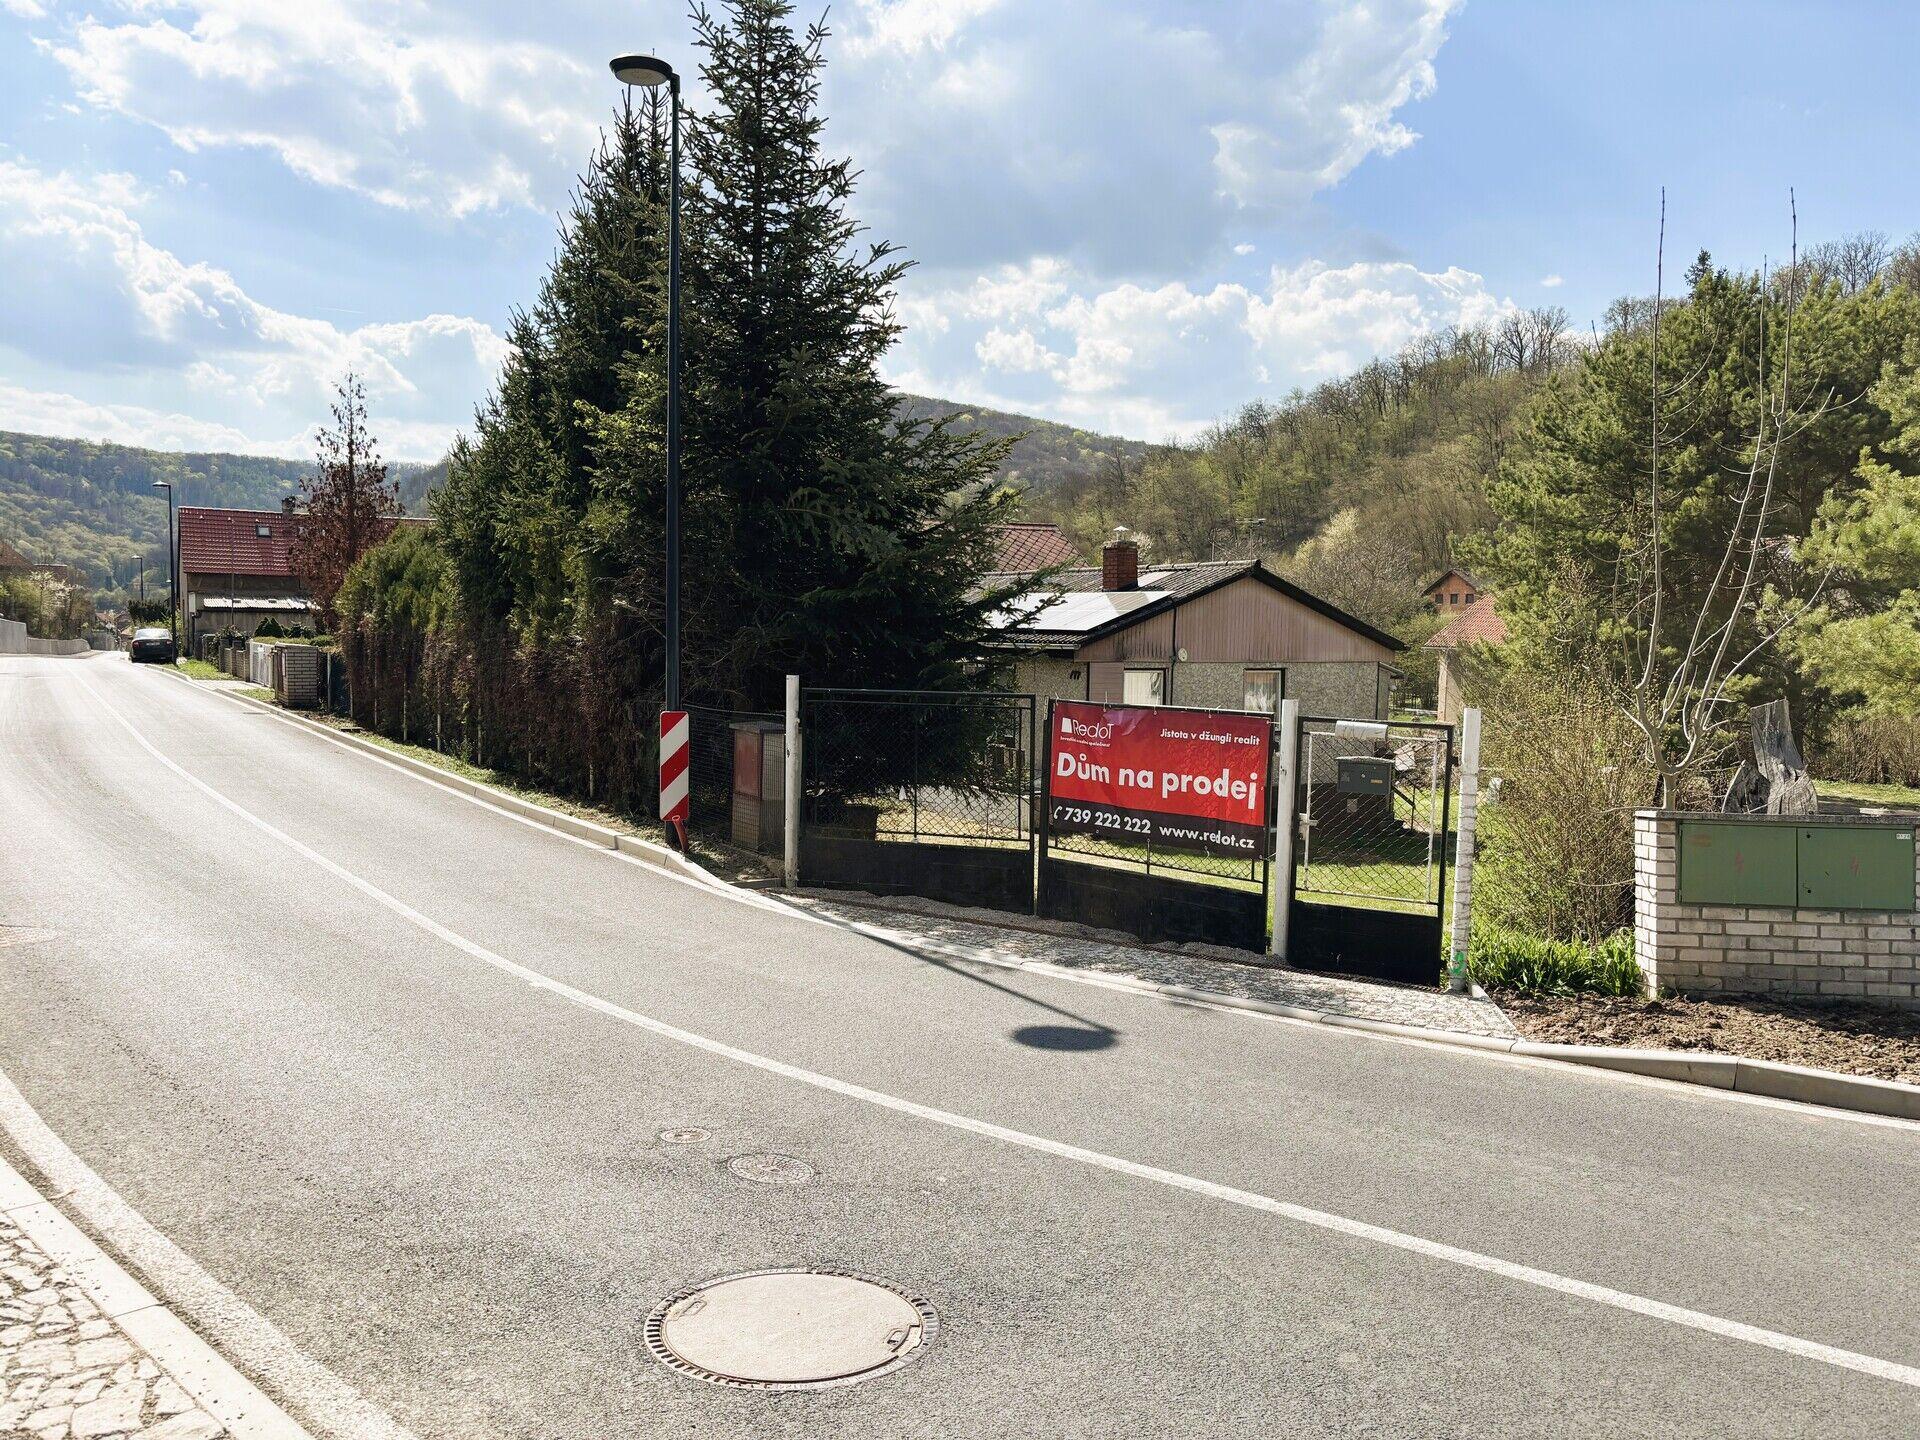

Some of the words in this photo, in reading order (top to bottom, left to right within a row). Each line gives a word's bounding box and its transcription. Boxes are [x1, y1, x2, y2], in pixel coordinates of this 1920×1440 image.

[1160, 729, 1188, 739] Jistota
[1191, 732, 1197, 740] v
[1199, 730, 1231, 745] džungli
[1234, 735, 1261, 746] realit
[1057, 752, 1110, 784] Dům
[1118, 768, 1154, 789] na
[1162, 768, 1257, 810] prodej
[1063, 807, 1091, 824] 739
[1095, 812, 1121, 830] 222
[1124, 817, 1151, 834] 222
[1159, 825, 1255, 849] www.redot.cz
